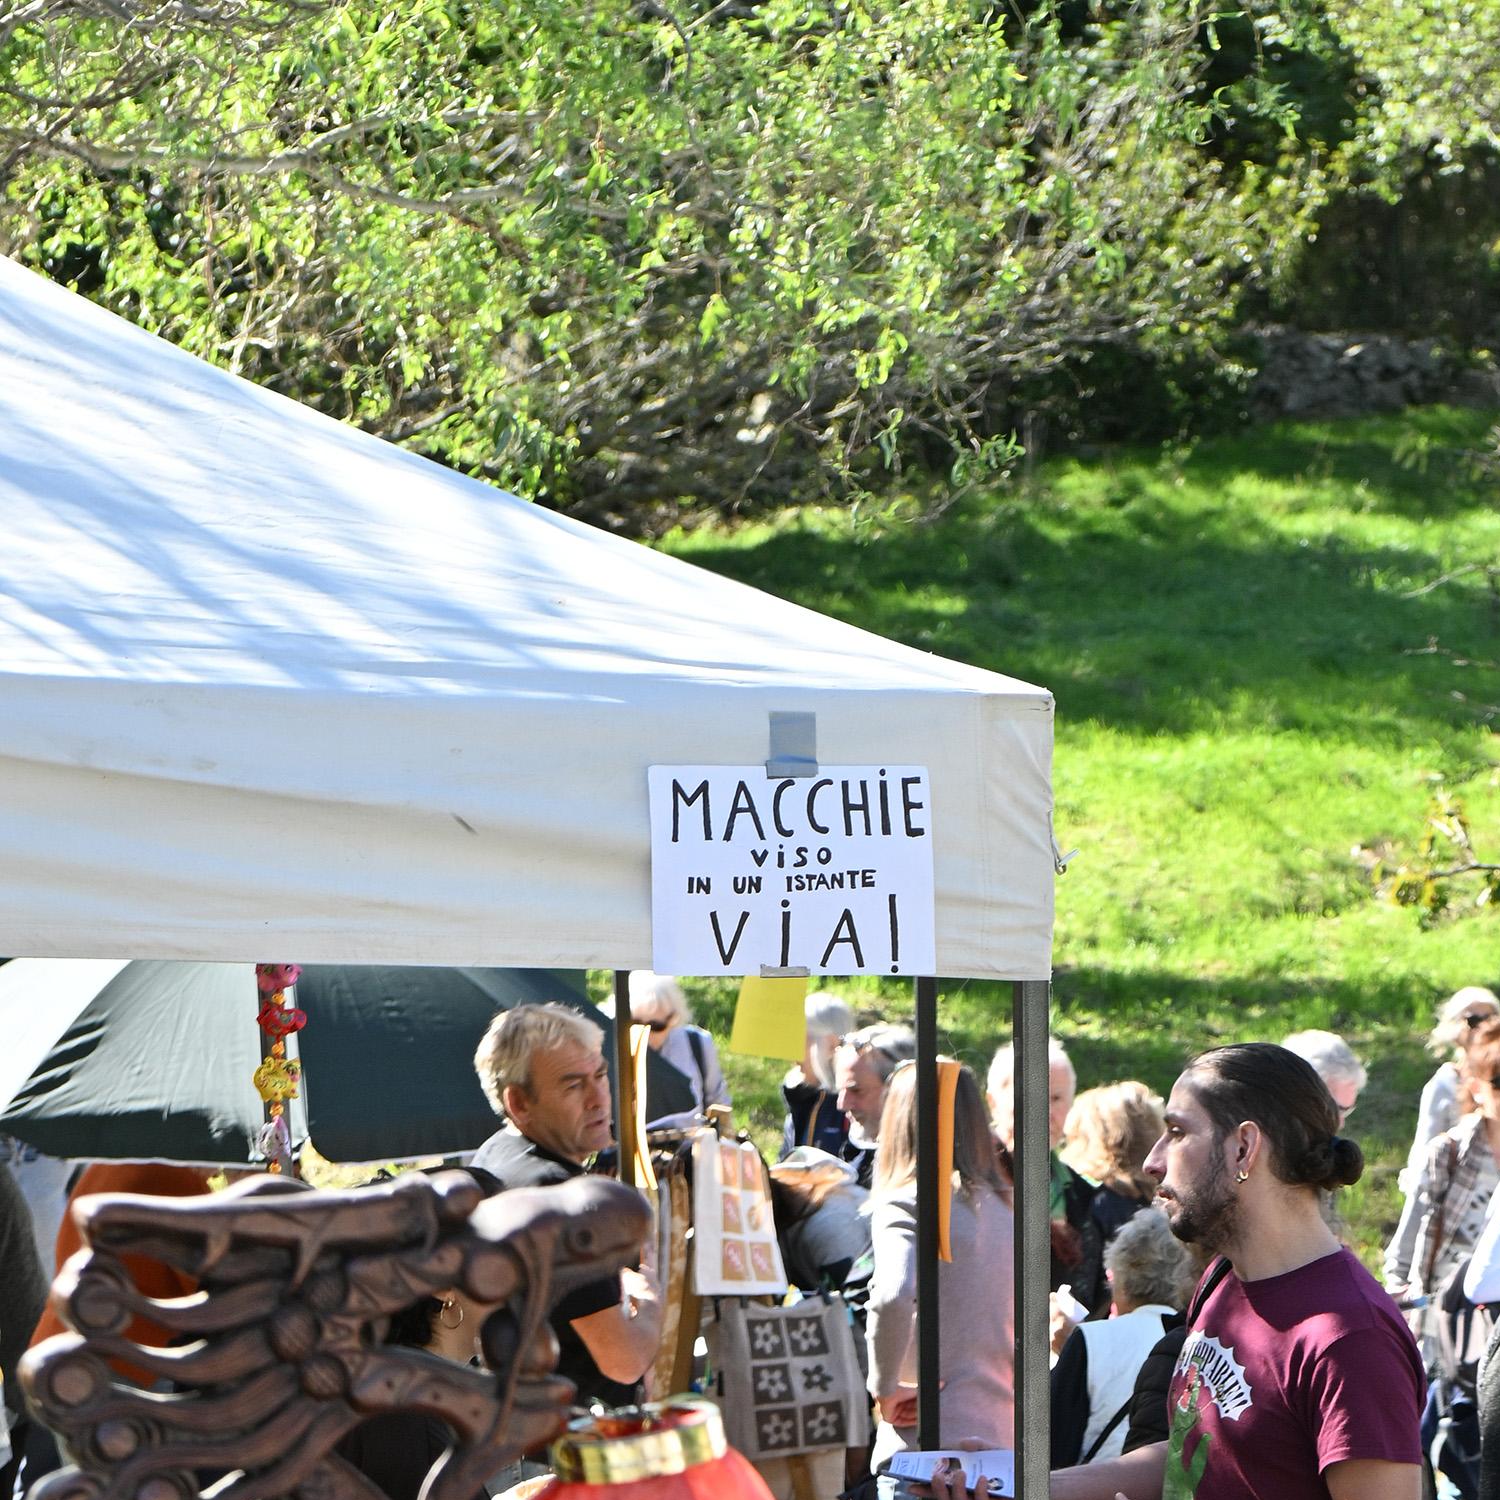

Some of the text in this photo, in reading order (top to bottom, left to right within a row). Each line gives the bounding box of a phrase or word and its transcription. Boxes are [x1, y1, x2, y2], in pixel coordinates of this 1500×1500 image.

[687, 869, 877, 894] IN UN ISTANTE
